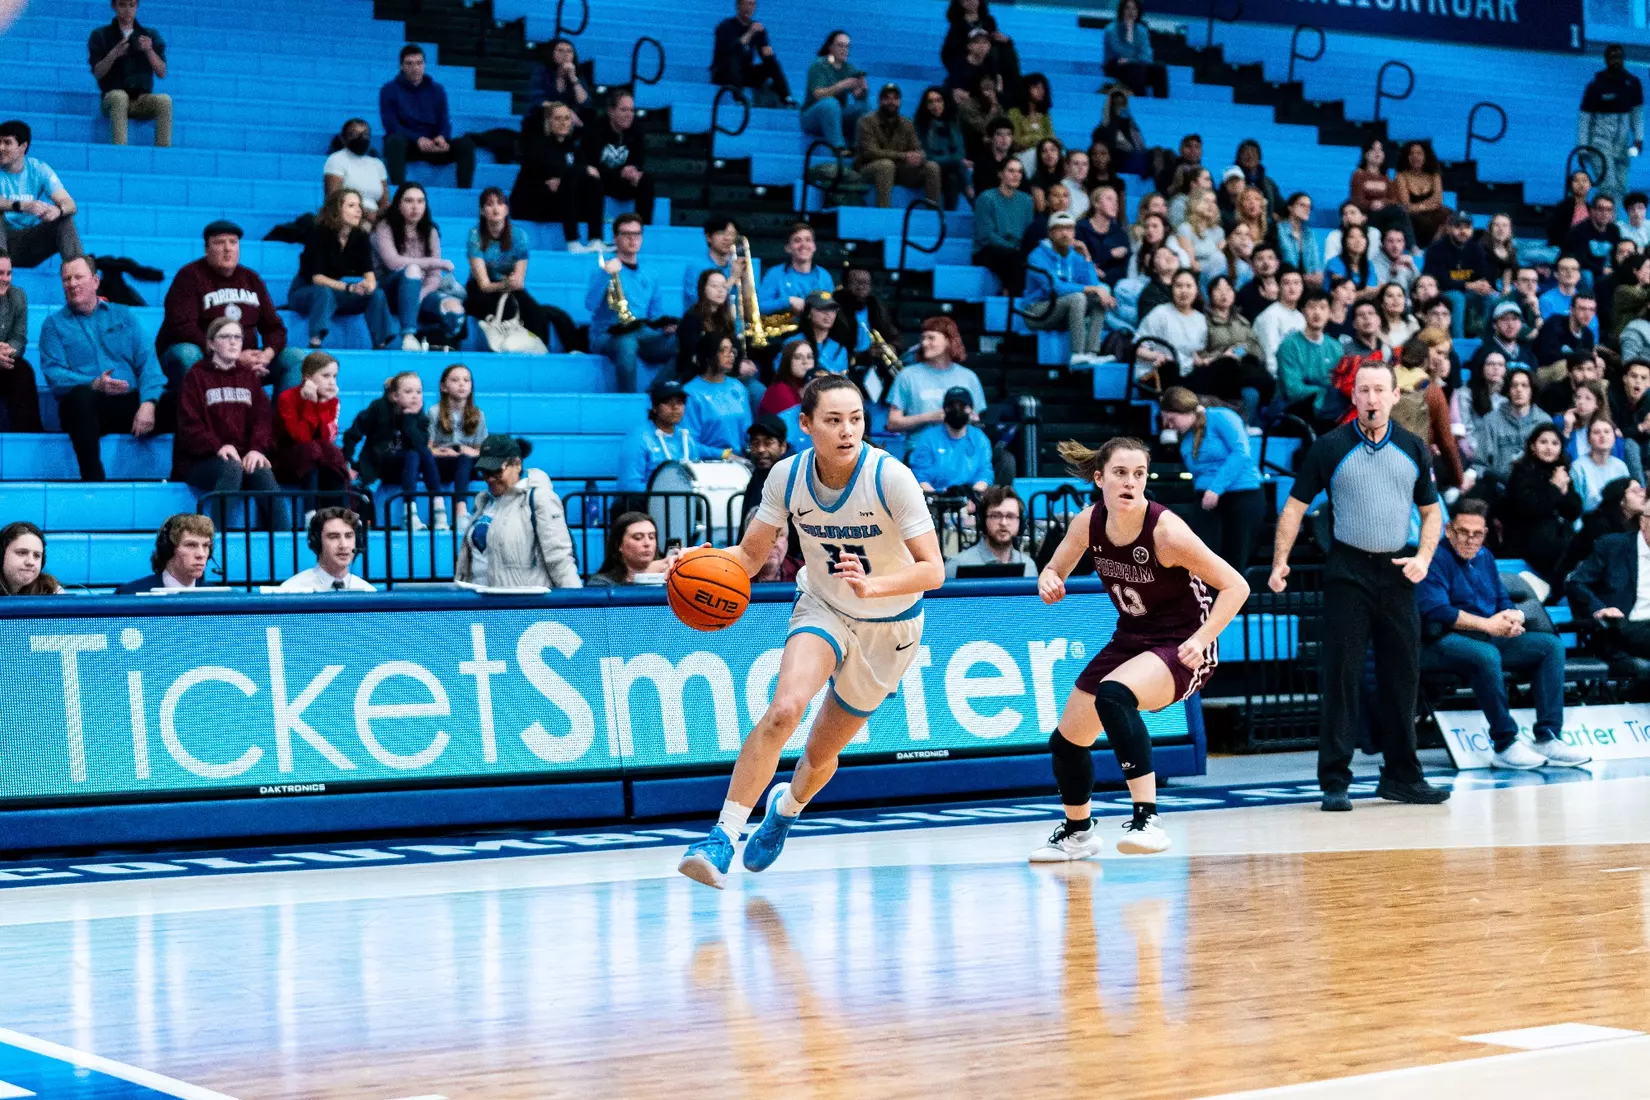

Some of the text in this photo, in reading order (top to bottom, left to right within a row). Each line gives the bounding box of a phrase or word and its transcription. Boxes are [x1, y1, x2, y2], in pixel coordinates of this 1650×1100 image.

[1111, 583, 1147, 617] 13
[896, 744, 950, 760] DAKTRONICS
[259, 783, 326, 795] DAKTRONICS
